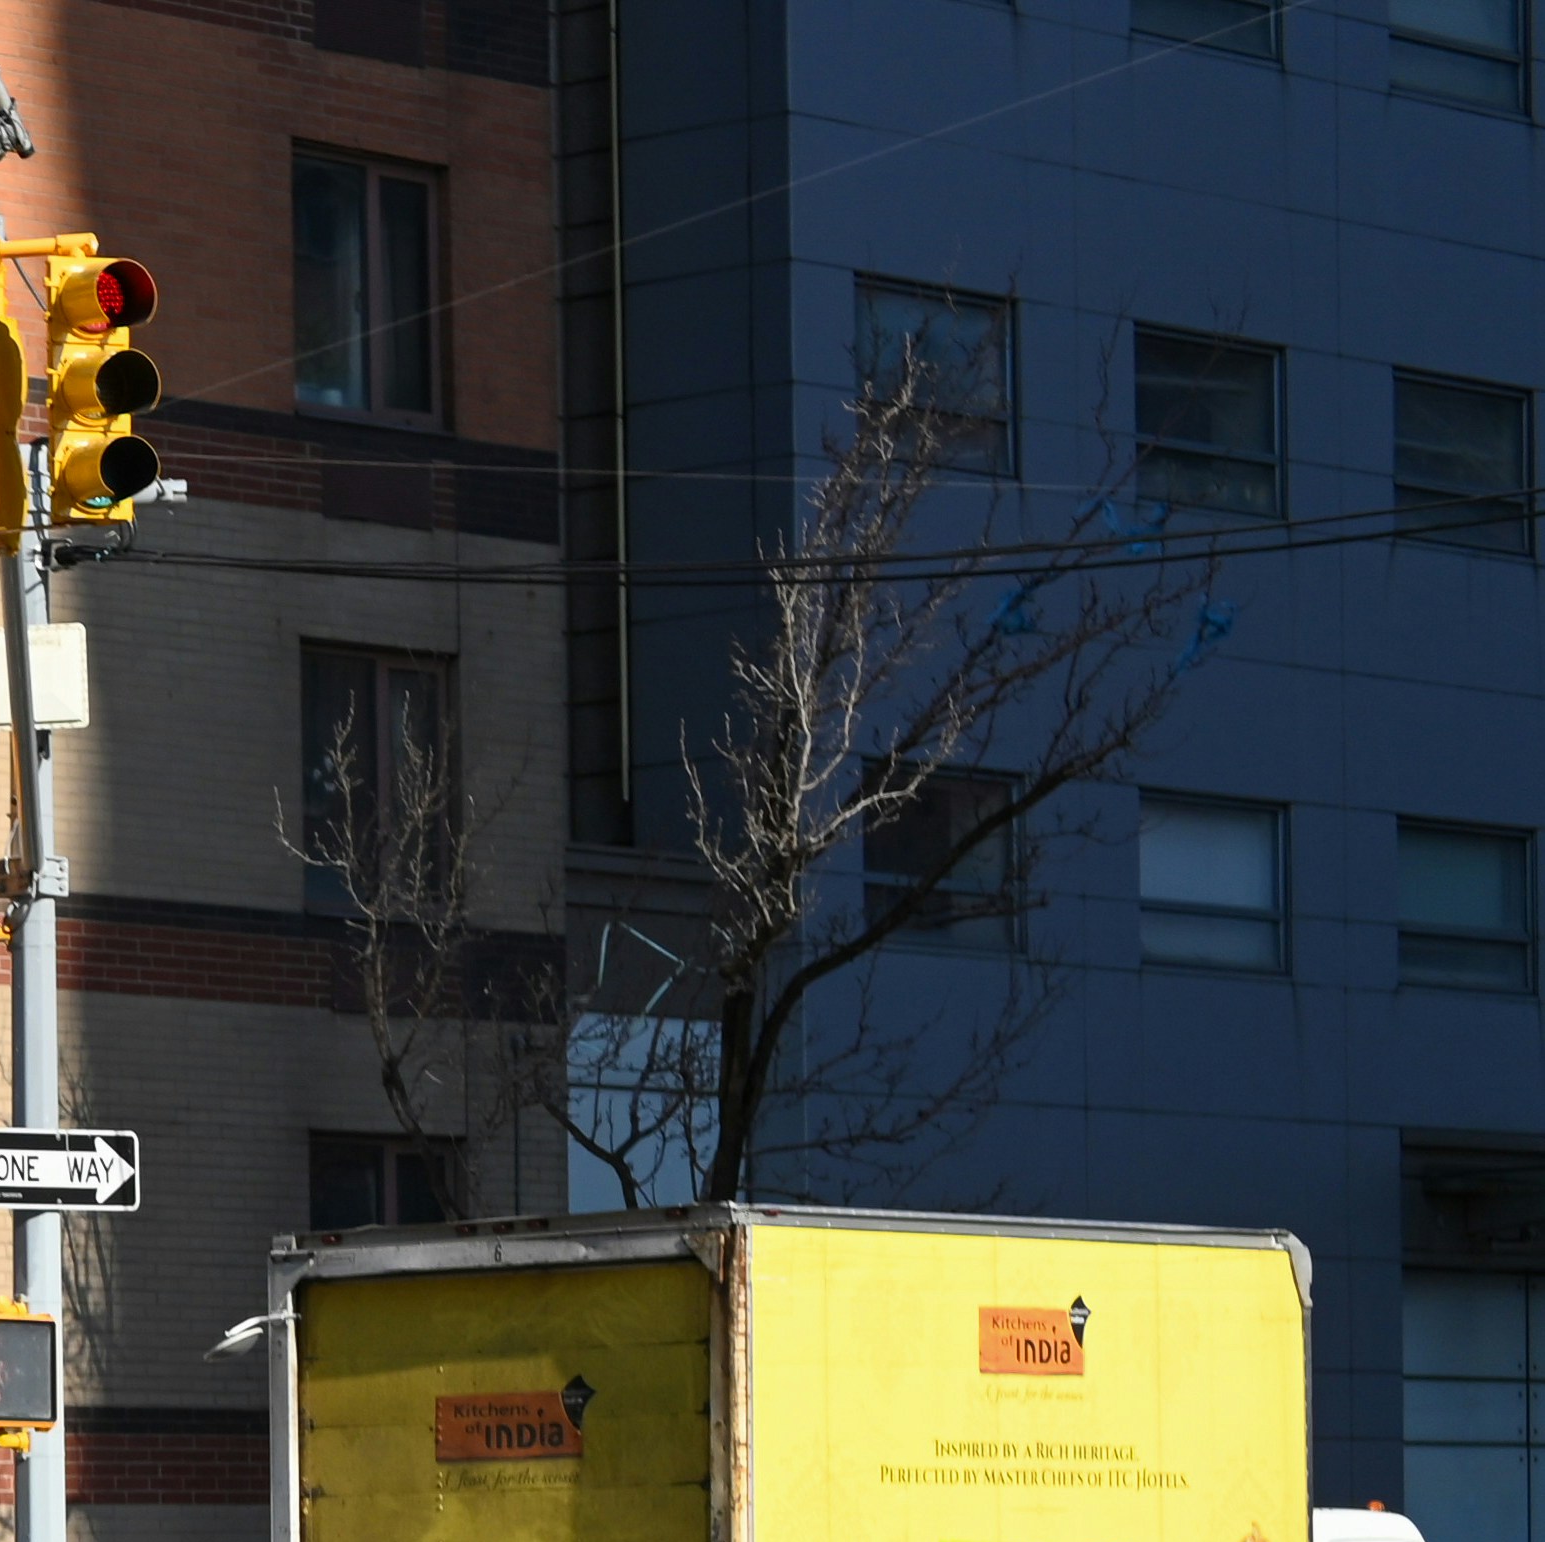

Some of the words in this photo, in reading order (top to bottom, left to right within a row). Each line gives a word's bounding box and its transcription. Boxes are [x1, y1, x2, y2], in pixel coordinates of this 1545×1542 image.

[66, 1156, 114, 1183] WAY
[495, 1245, 502, 1263] 6
[992, 1316, 1047, 1331] Kitchens
[1001, 1335, 1013, 1346] of
[453, 1402, 530, 1419] Kitchens
[465, 1420, 482, 1434] of
